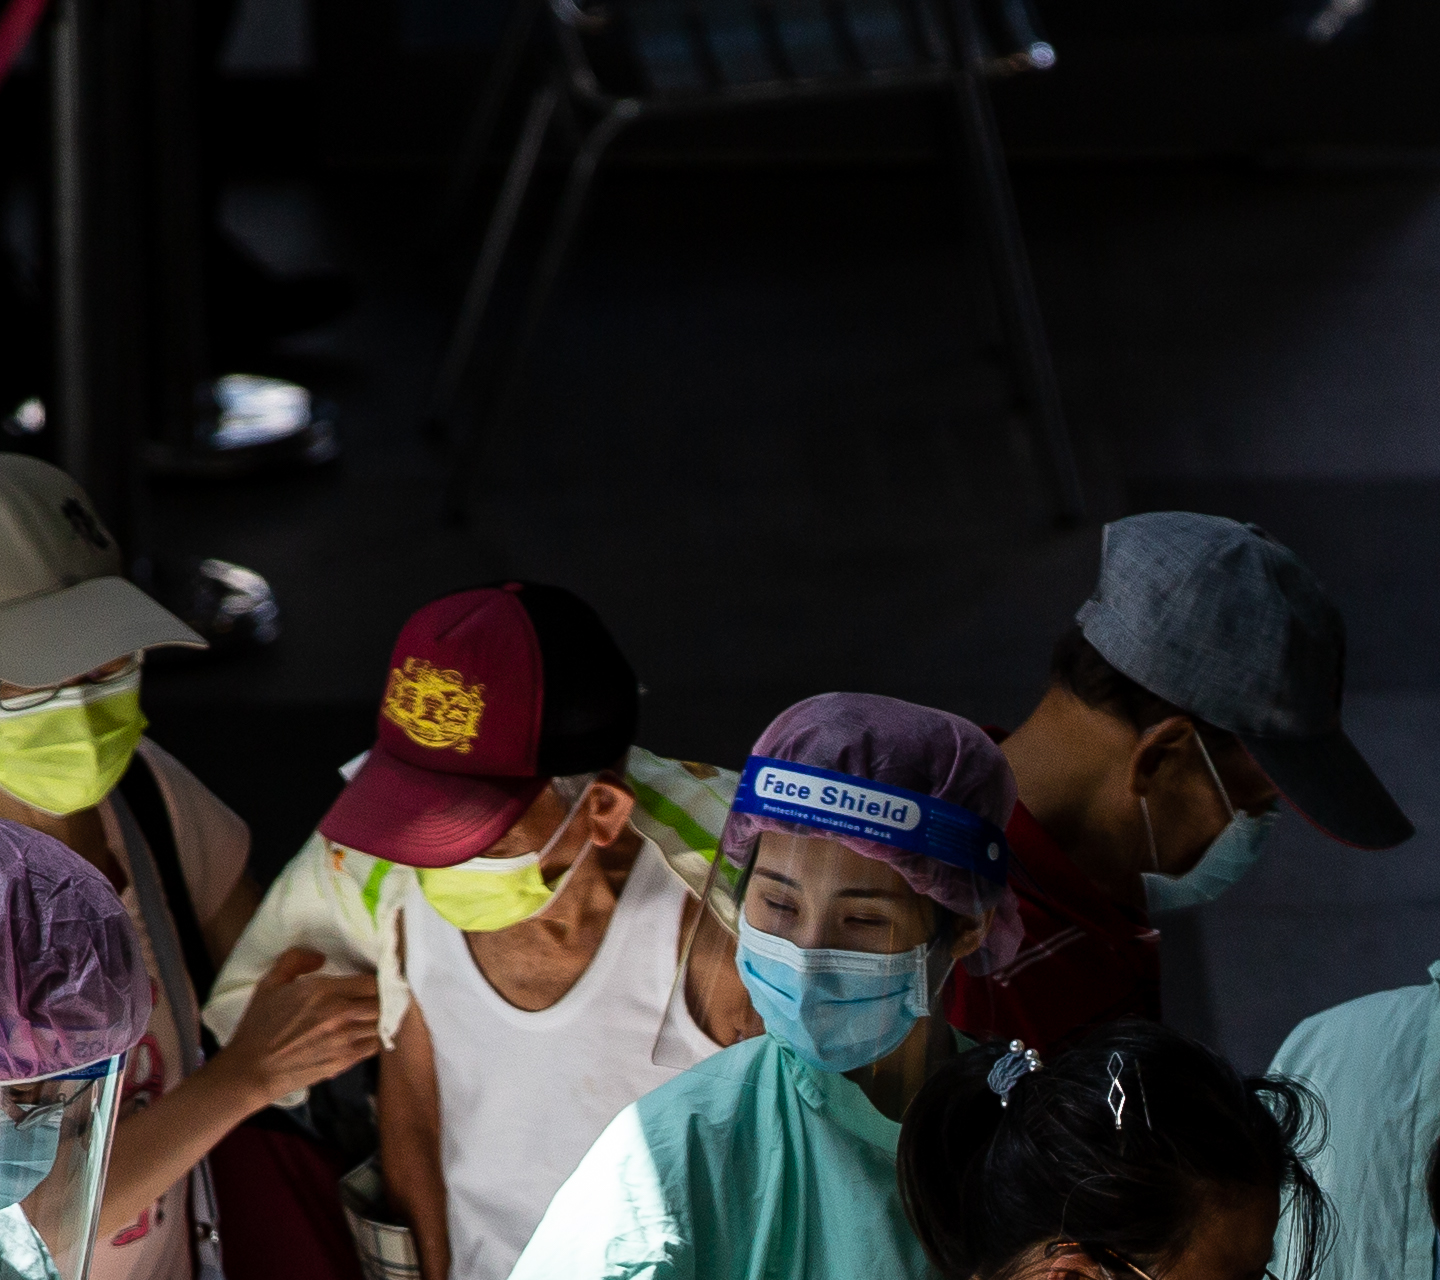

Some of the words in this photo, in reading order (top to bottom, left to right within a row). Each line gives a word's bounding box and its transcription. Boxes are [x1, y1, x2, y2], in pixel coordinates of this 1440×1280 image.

[762, 773, 810, 801] Face
[819, 785, 909, 824] Shield
[763, 803, 809, 821] Protective
[811, 814, 860, 832] Isolation
[864, 826, 892, 840] Mask
